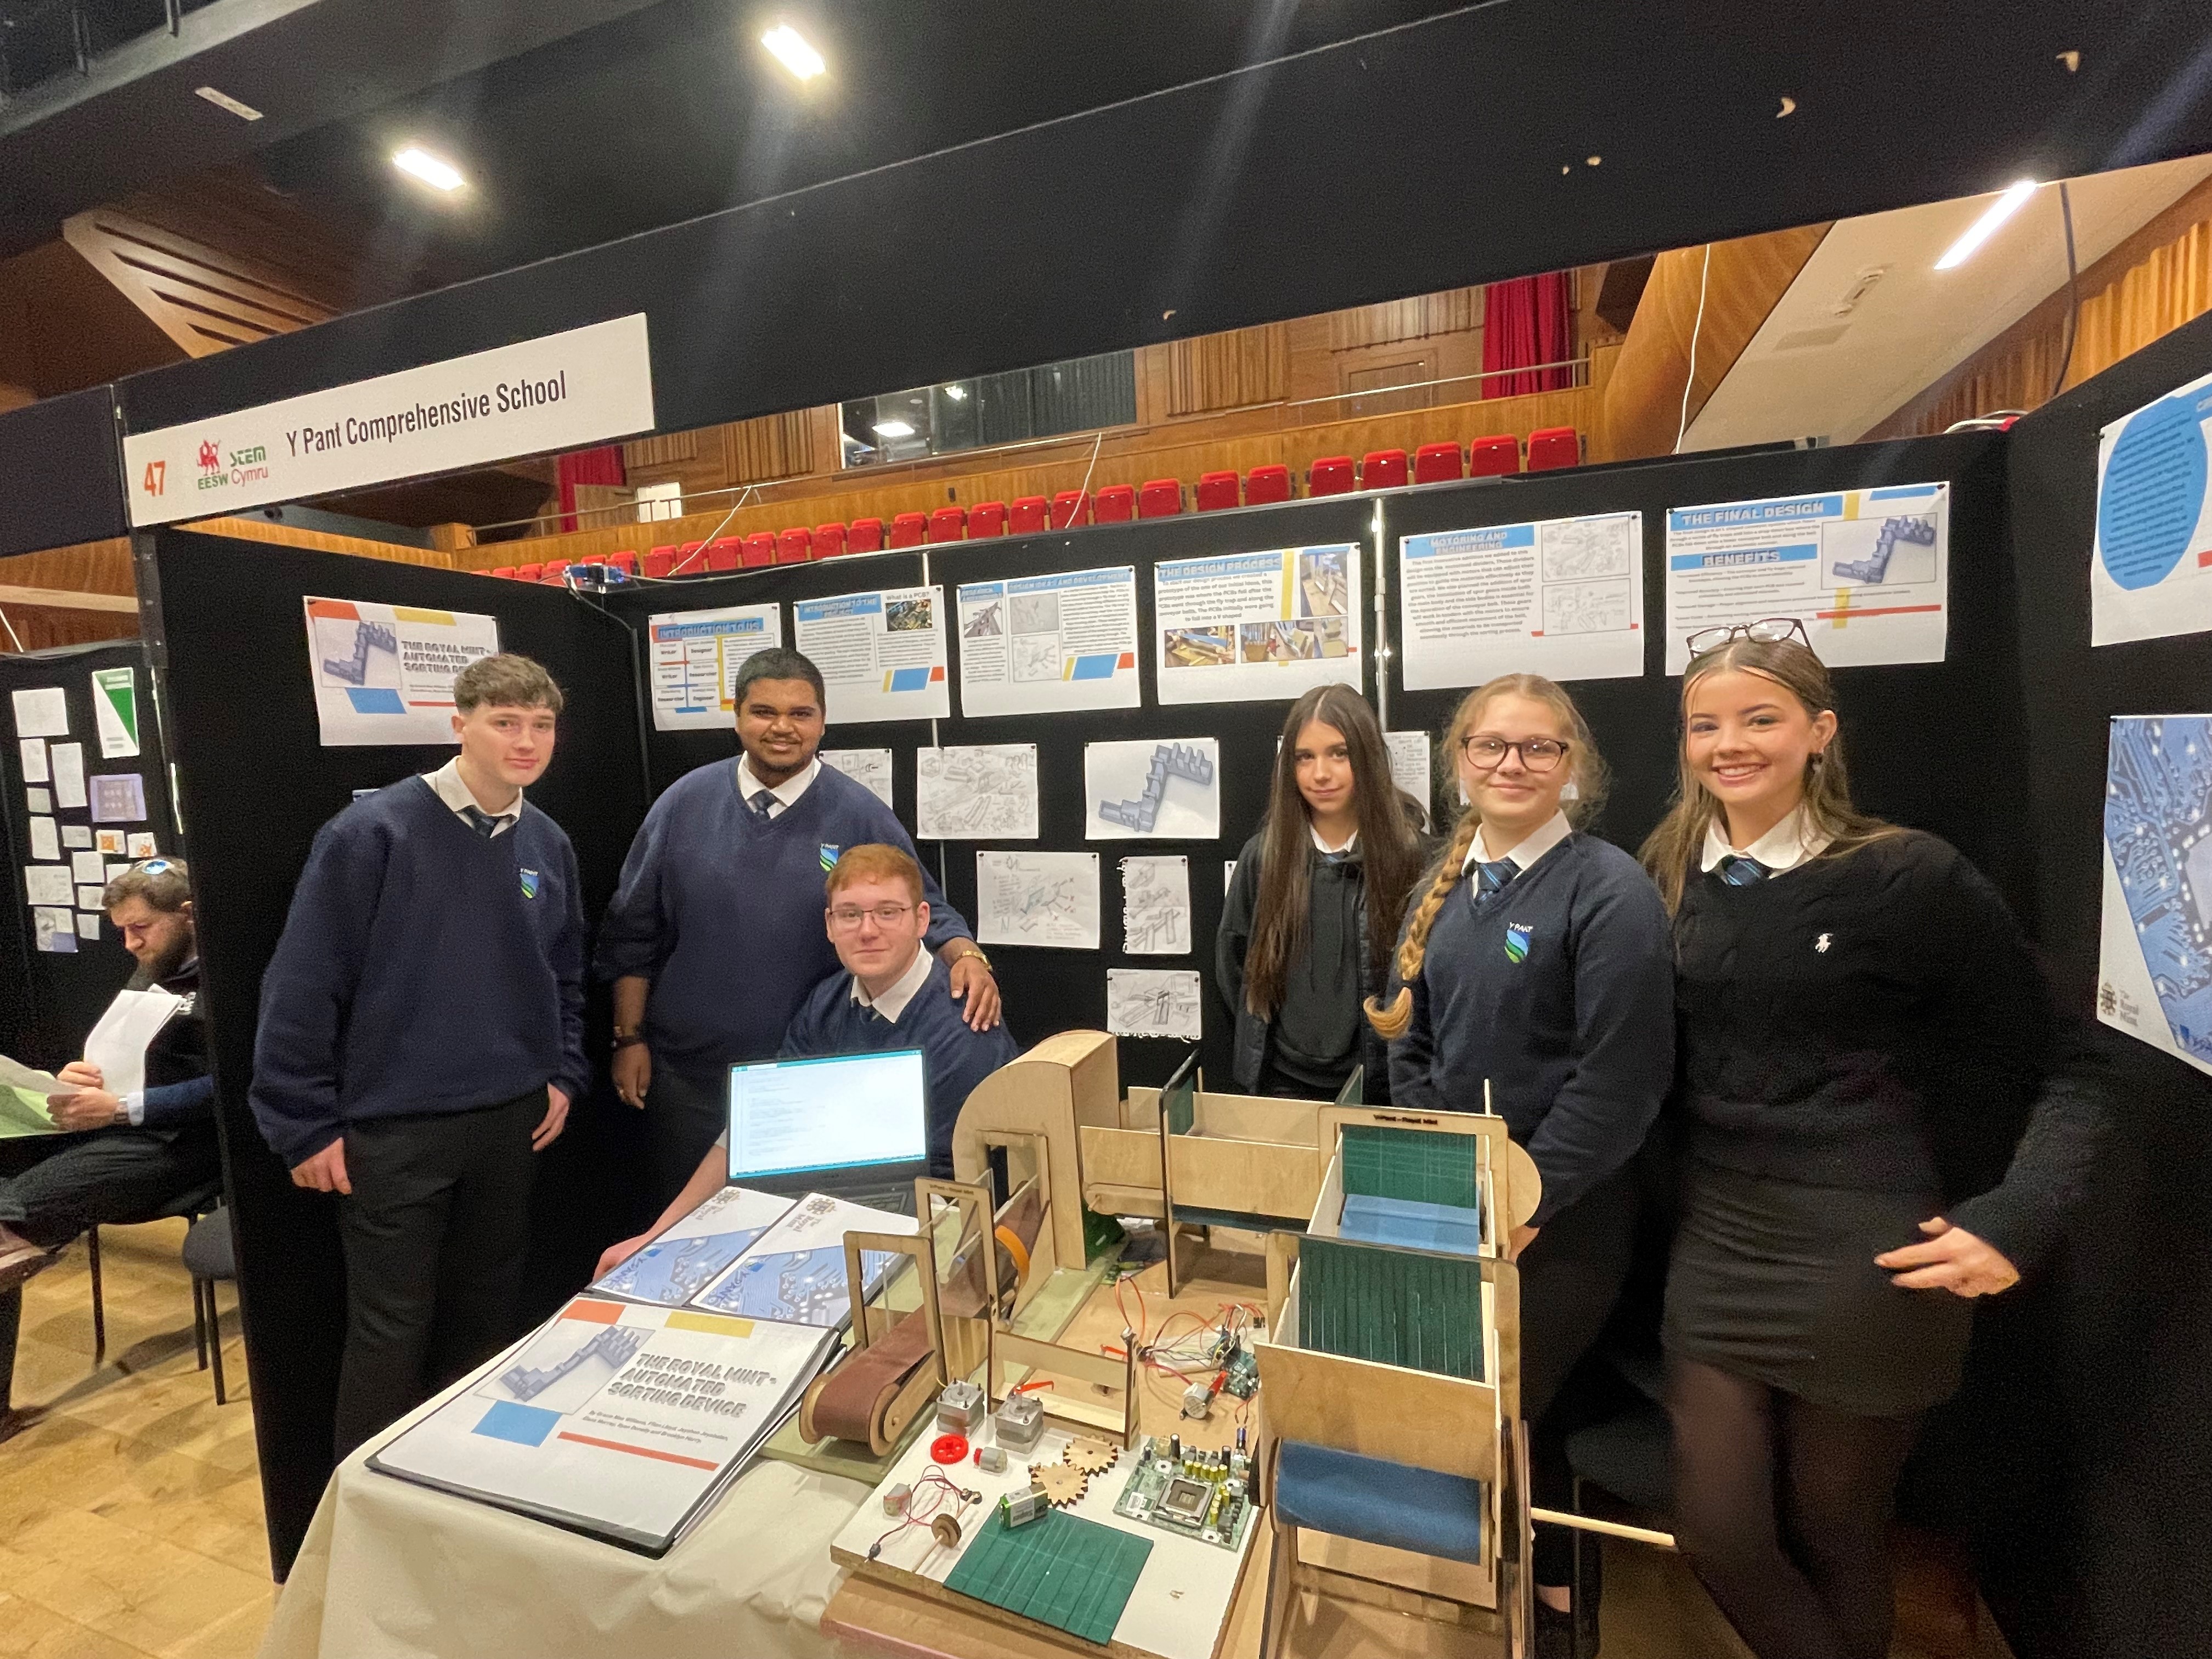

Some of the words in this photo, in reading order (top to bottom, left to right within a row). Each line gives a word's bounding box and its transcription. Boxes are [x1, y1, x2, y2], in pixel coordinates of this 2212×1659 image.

[286, 430, 297, 456] Y
[303, 422, 342, 453] Pant
[346, 392, 491, 443] Comprehensive
[495, 370, 567, 413] School
[144, 460, 165, 496] 47
[198, 473, 228, 490] EESW
[232, 466, 268, 487] Cymru
[1681, 511, 1711, 526] THE
[1714, 507, 1762, 523] FINAL
[1763, 500, 1824, 518] DESIGN
[1430, 534, 1483, 547] MOTORING
[1485, 531, 1508, 540] AND
[1159, 566, 1181, 578] THE
[1182, 562, 1222, 576] DESIGN
[1224, 557, 1282, 572] PROCESS
[1702, 549, 1781, 567] BENEFITS
[659, 624, 727, 638] INTRODUCTION
[729, 623, 743, 633] TO
[744, 621, 759, 631] US
[402, 641, 423, 651] THE
[425, 642, 459, 654] ROYAL
[403, 652, 469, 664] AUTOMATED
[404, 663, 452, 674] SORTING
[635, 1353, 670, 1370] THE
[665, 1358, 723, 1380] ROYAL
[723, 1366, 770, 1387] MINT
[619, 1368, 726, 1397] AUTOMATED
[608, 1381, 682, 1407] SORTING
[679, 1394, 747, 1418] DEVICE
